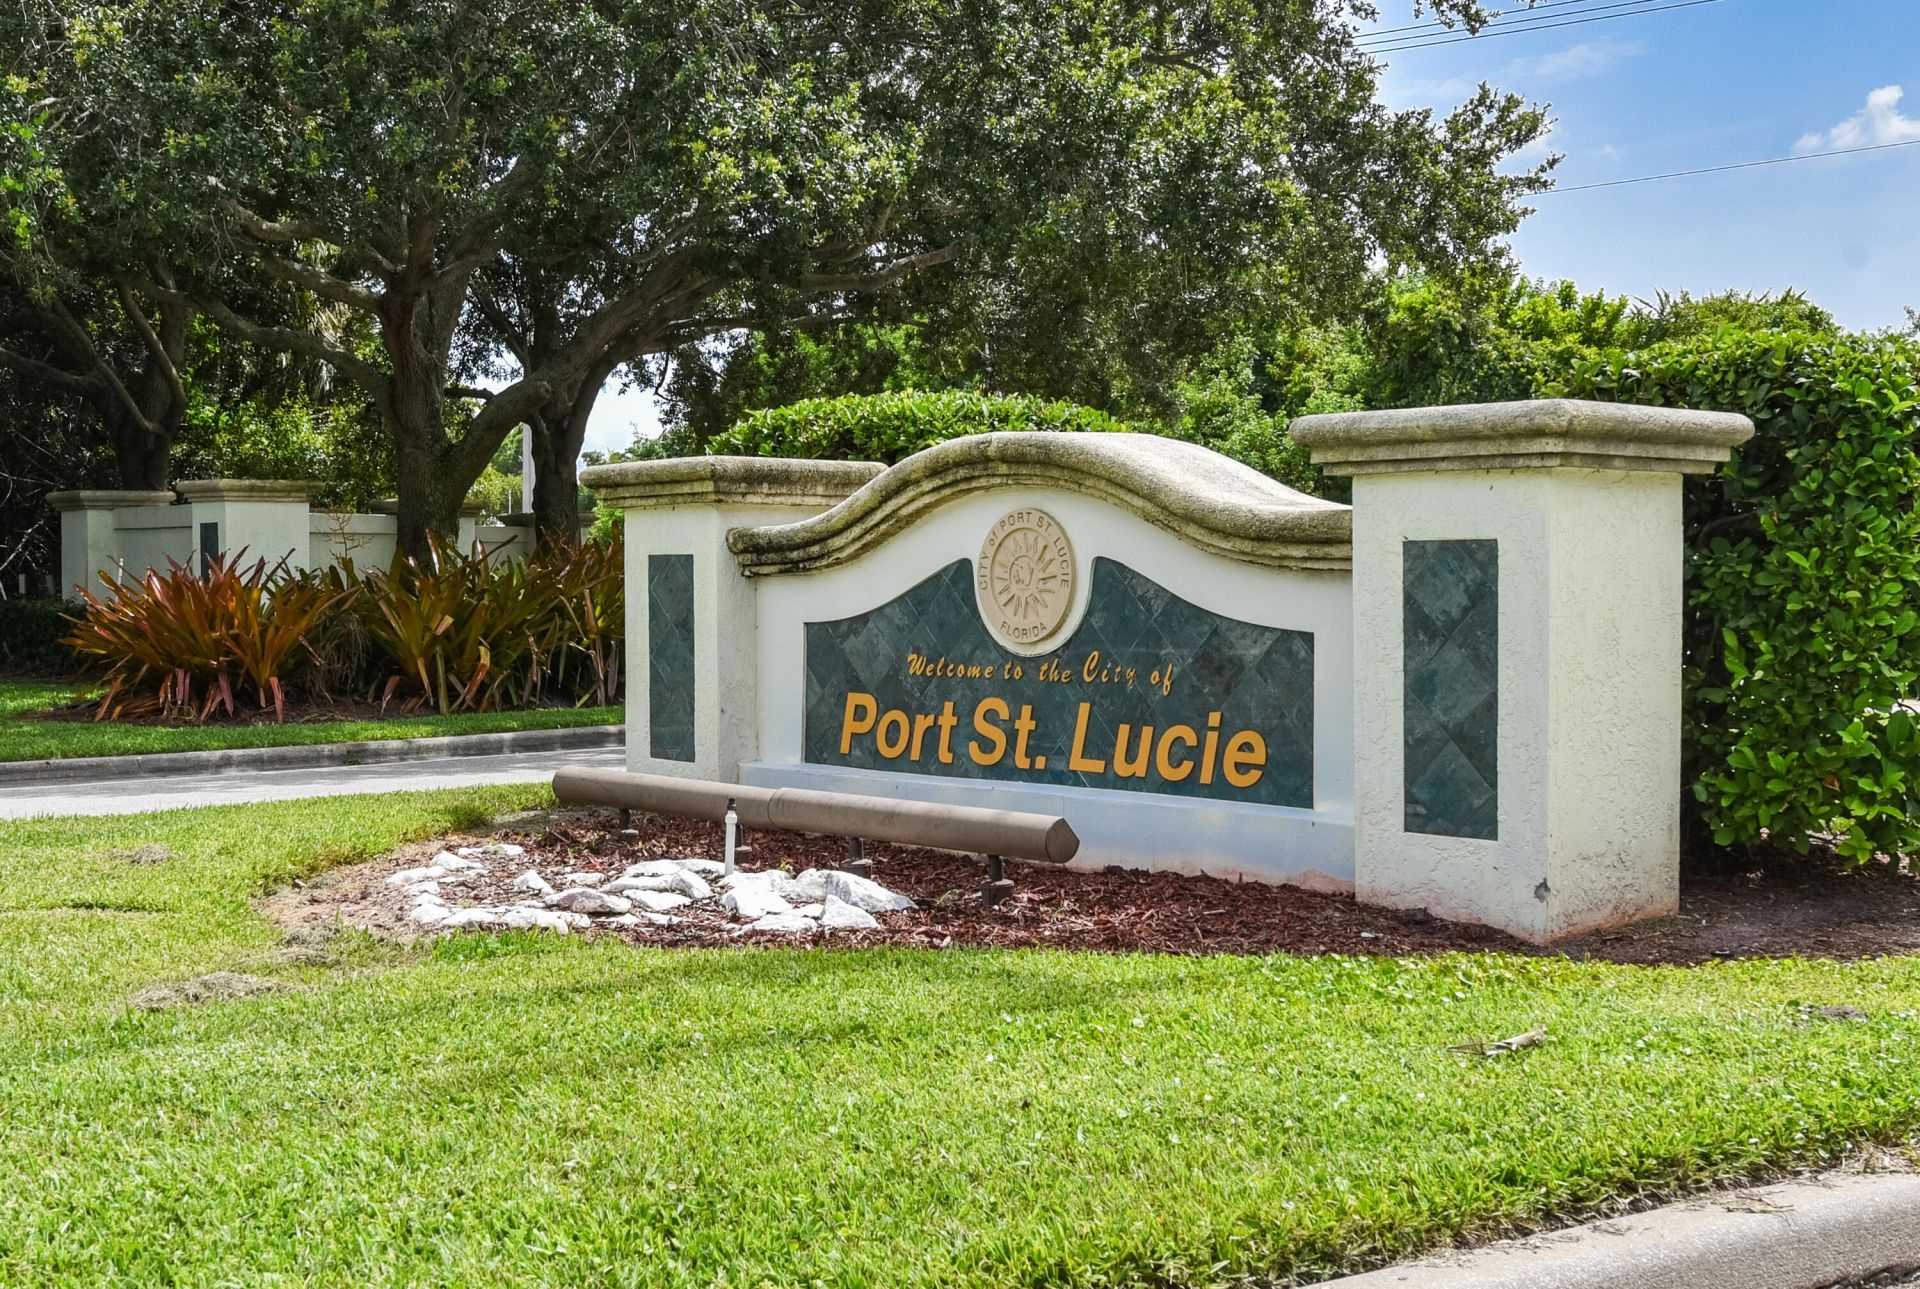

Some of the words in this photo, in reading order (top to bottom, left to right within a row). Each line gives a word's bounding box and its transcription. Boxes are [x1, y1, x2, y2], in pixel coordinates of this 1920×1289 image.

[979, 551, 990, 591] CITY
[989, 530, 999, 546] of
[1000, 511, 1032, 531] PORT
[1053, 537, 1070, 588] LUCIE
[1000, 620, 1047, 639] FLORIDA
[907, 653, 994, 679] Welcome
[1002, 661, 1023, 681] to
[1039, 657, 1071, 683] the
[1082, 650, 1136, 686] City
[1150, 663, 1174, 696] of
[839, 692, 958, 764] Port
[968, 696, 1046, 771] St.
[1068, 702, 1267, 788] Lucie
